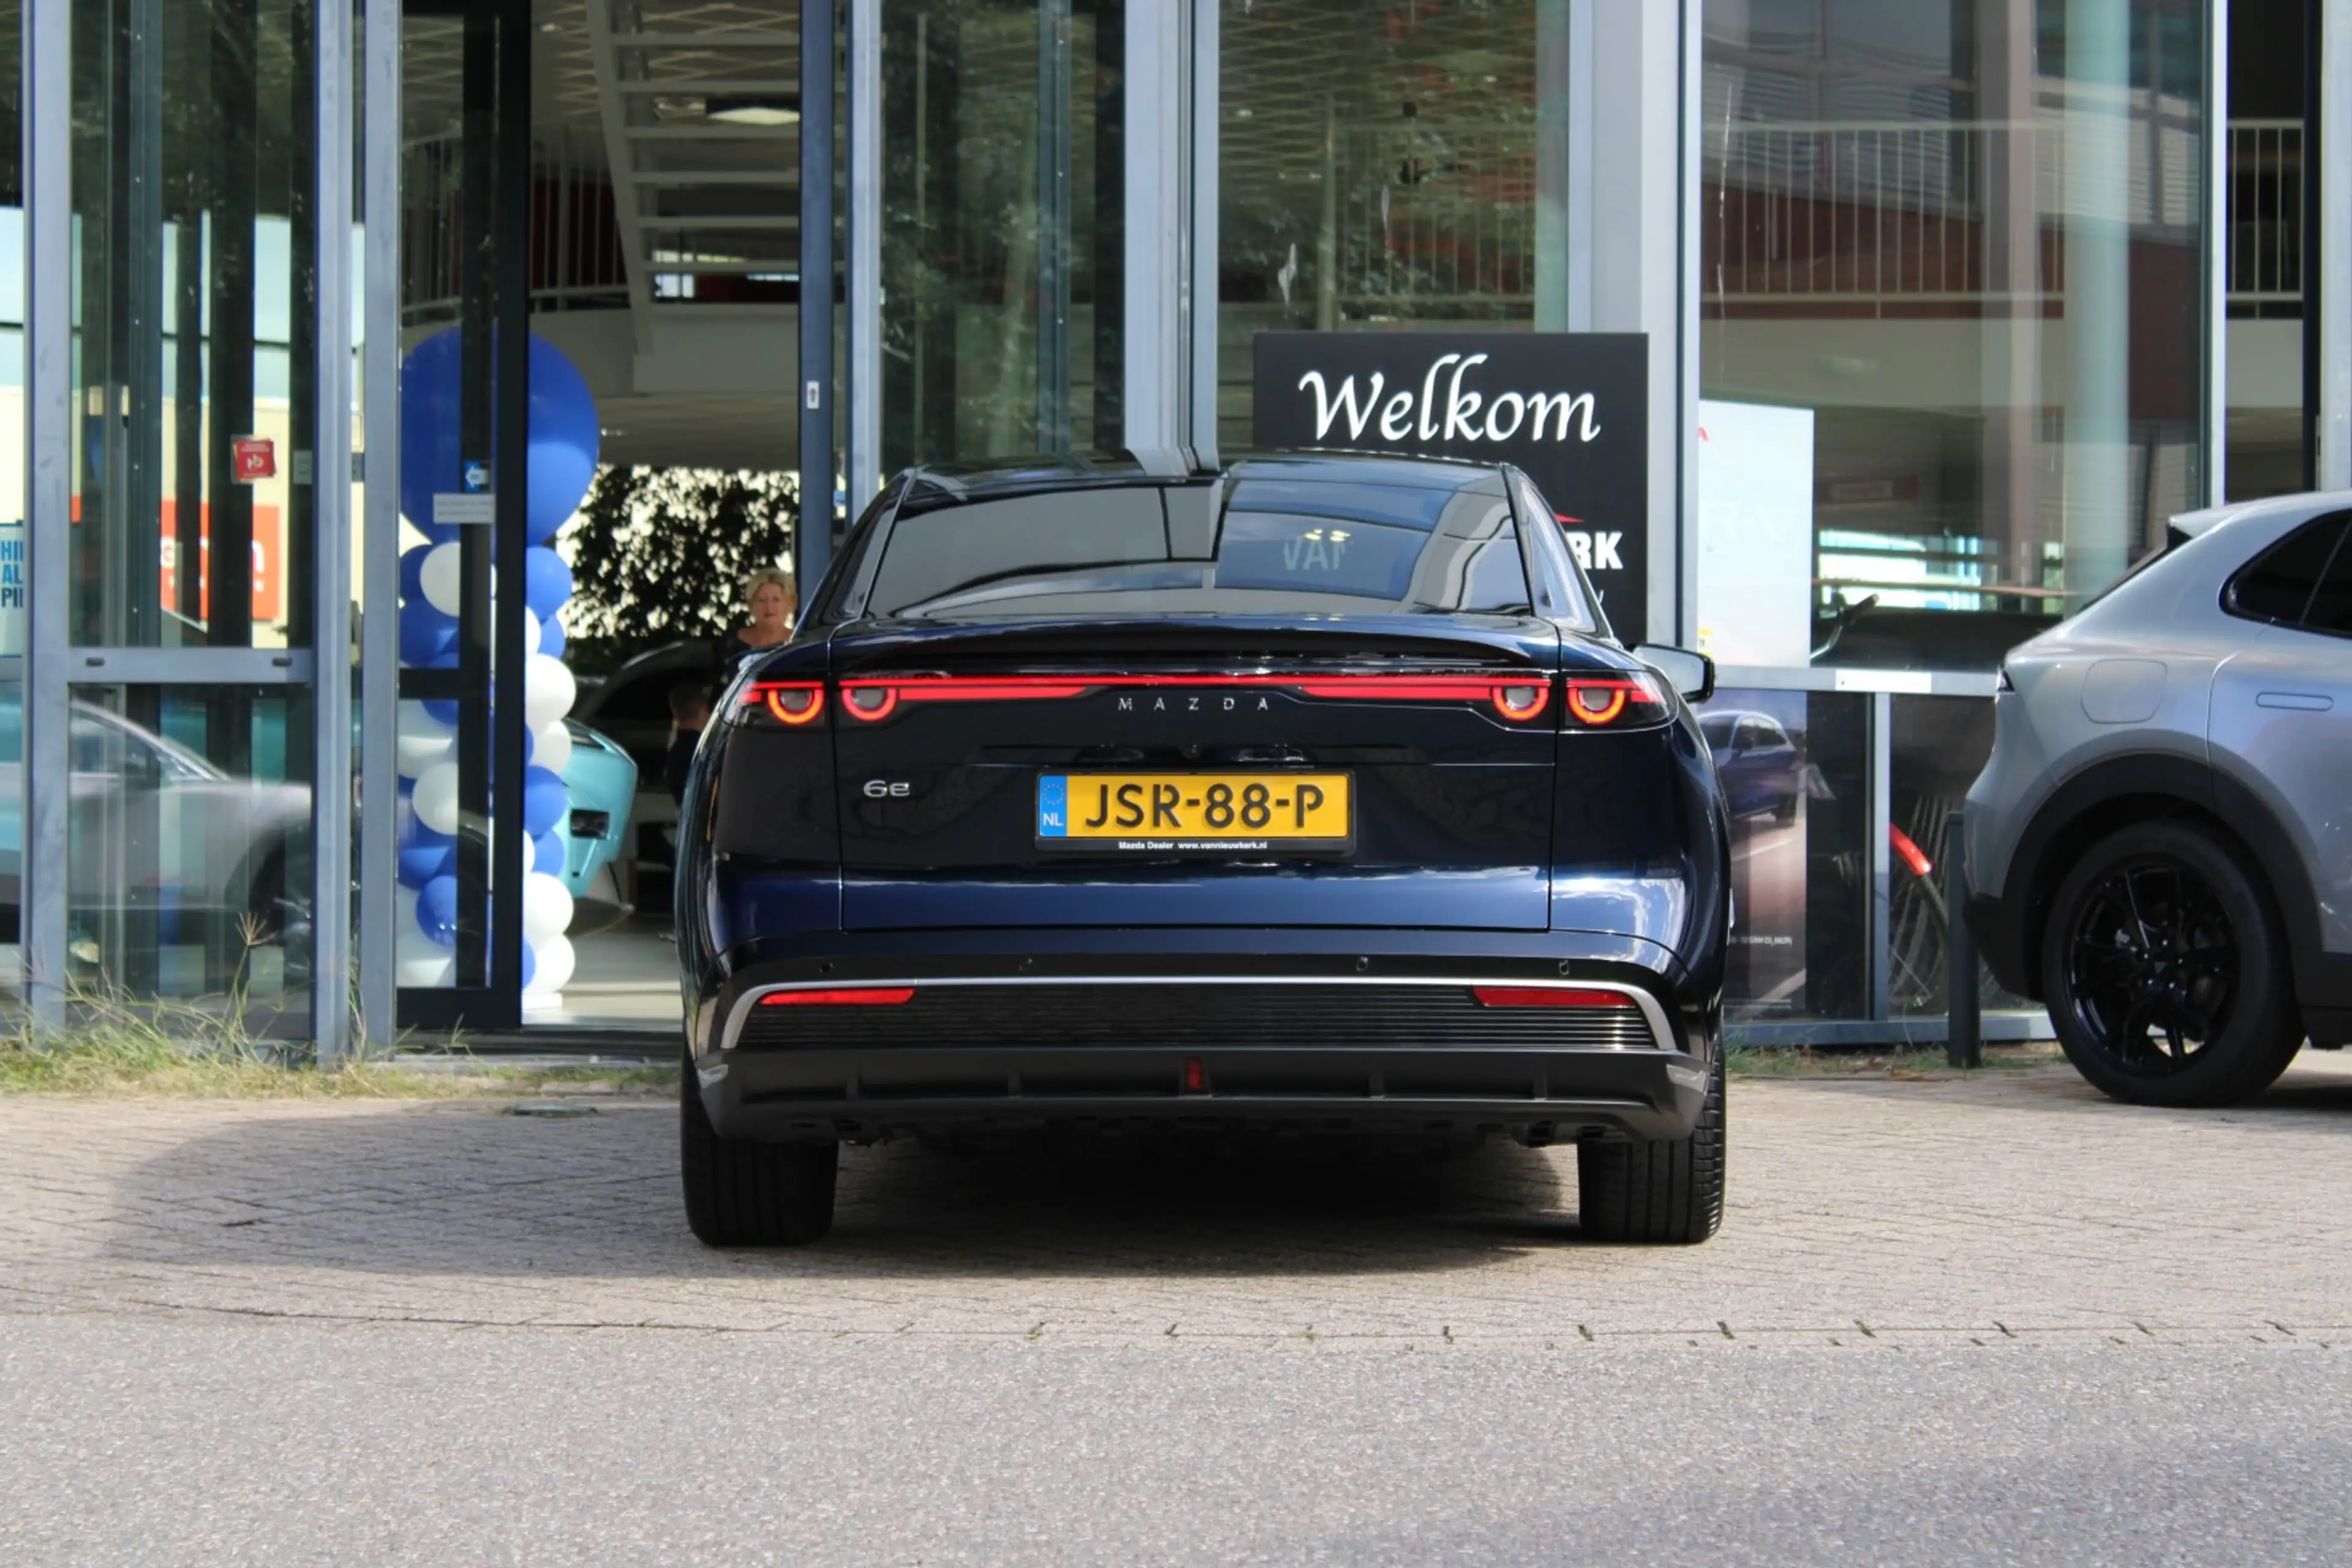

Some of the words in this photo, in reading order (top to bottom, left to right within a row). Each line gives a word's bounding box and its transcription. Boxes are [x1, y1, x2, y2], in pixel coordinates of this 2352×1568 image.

[1298, 353, 1600, 442] Welkom
[1118, 697, 1268, 710] MAZDA
[862, 780, 910, 797] 6e
[1085, 783, 1324, 829] JSR-88-P
[1043, 813, 1063, 826] NL
